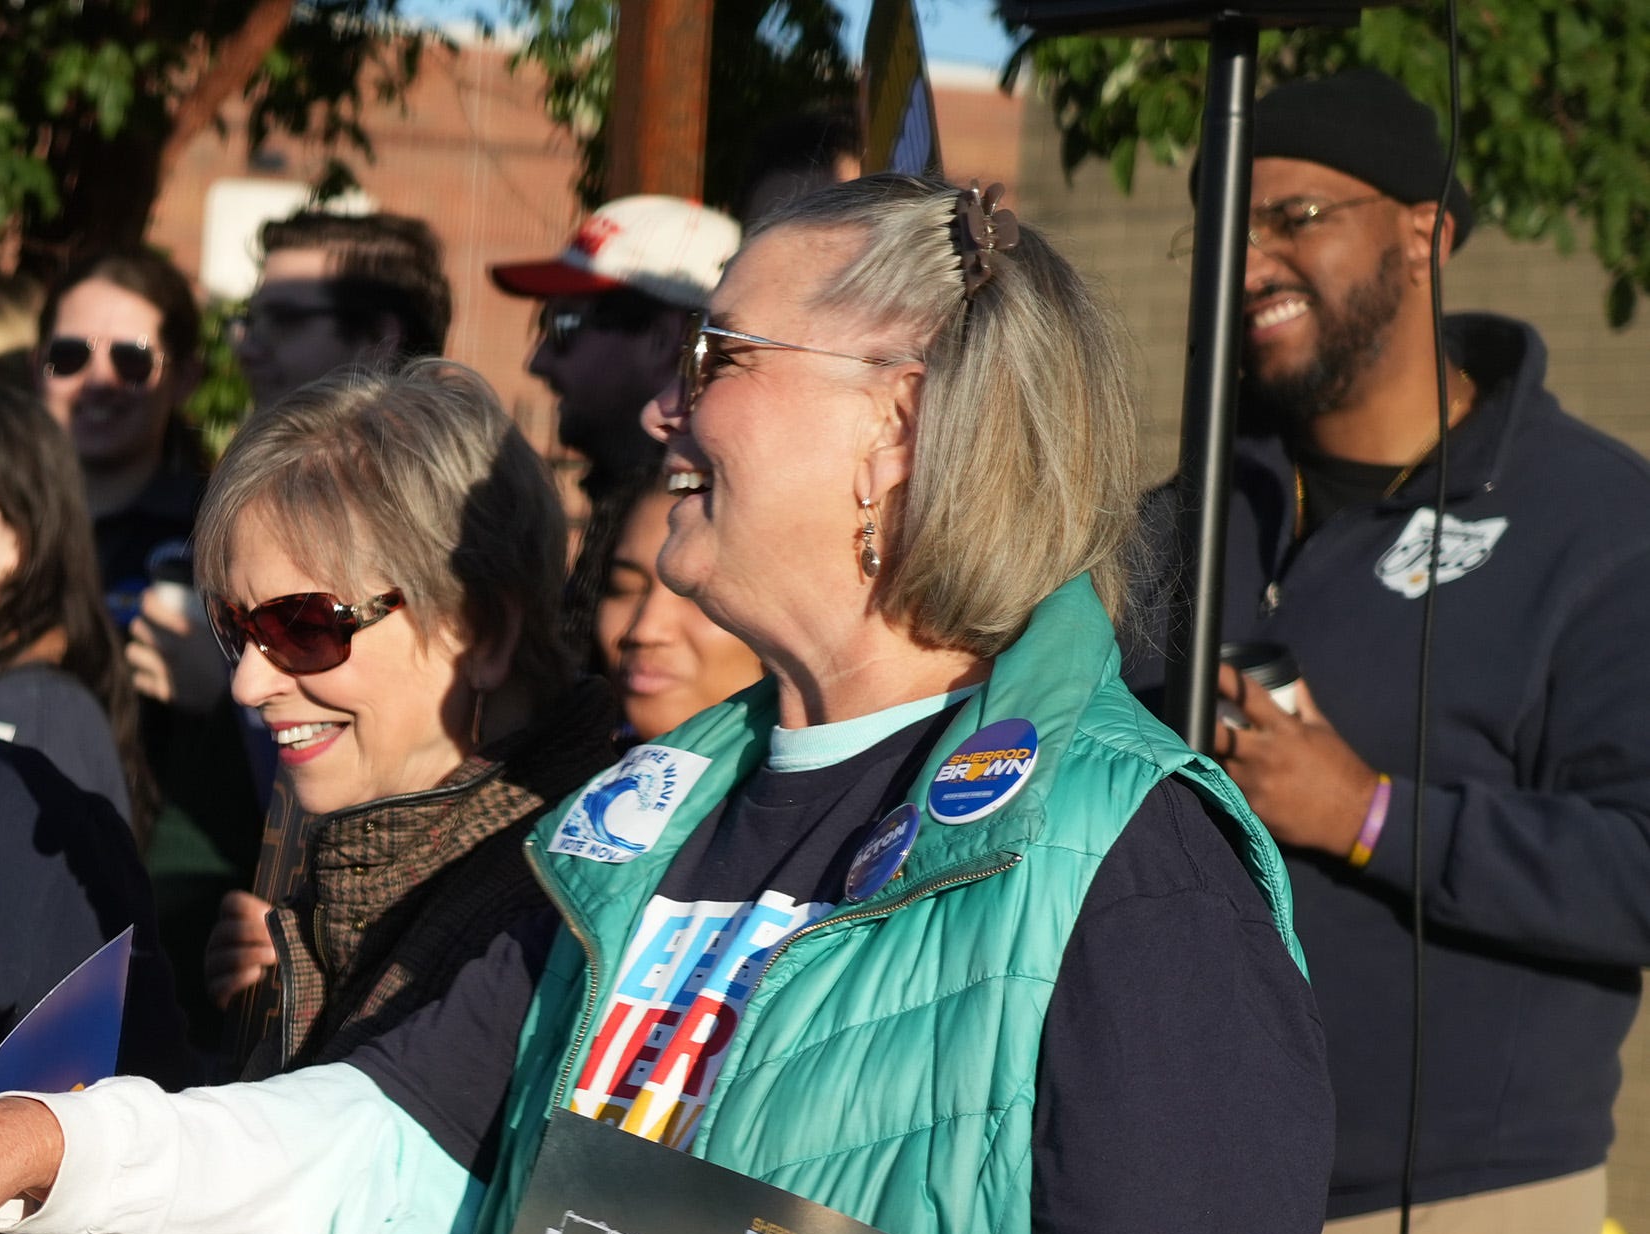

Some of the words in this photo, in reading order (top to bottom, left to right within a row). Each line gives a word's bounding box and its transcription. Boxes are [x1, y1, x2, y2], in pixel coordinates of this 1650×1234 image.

[948, 748, 1031, 765] SHERROD
[653, 763, 678, 813] WAVE
[851, 821, 908, 870] ACTON
